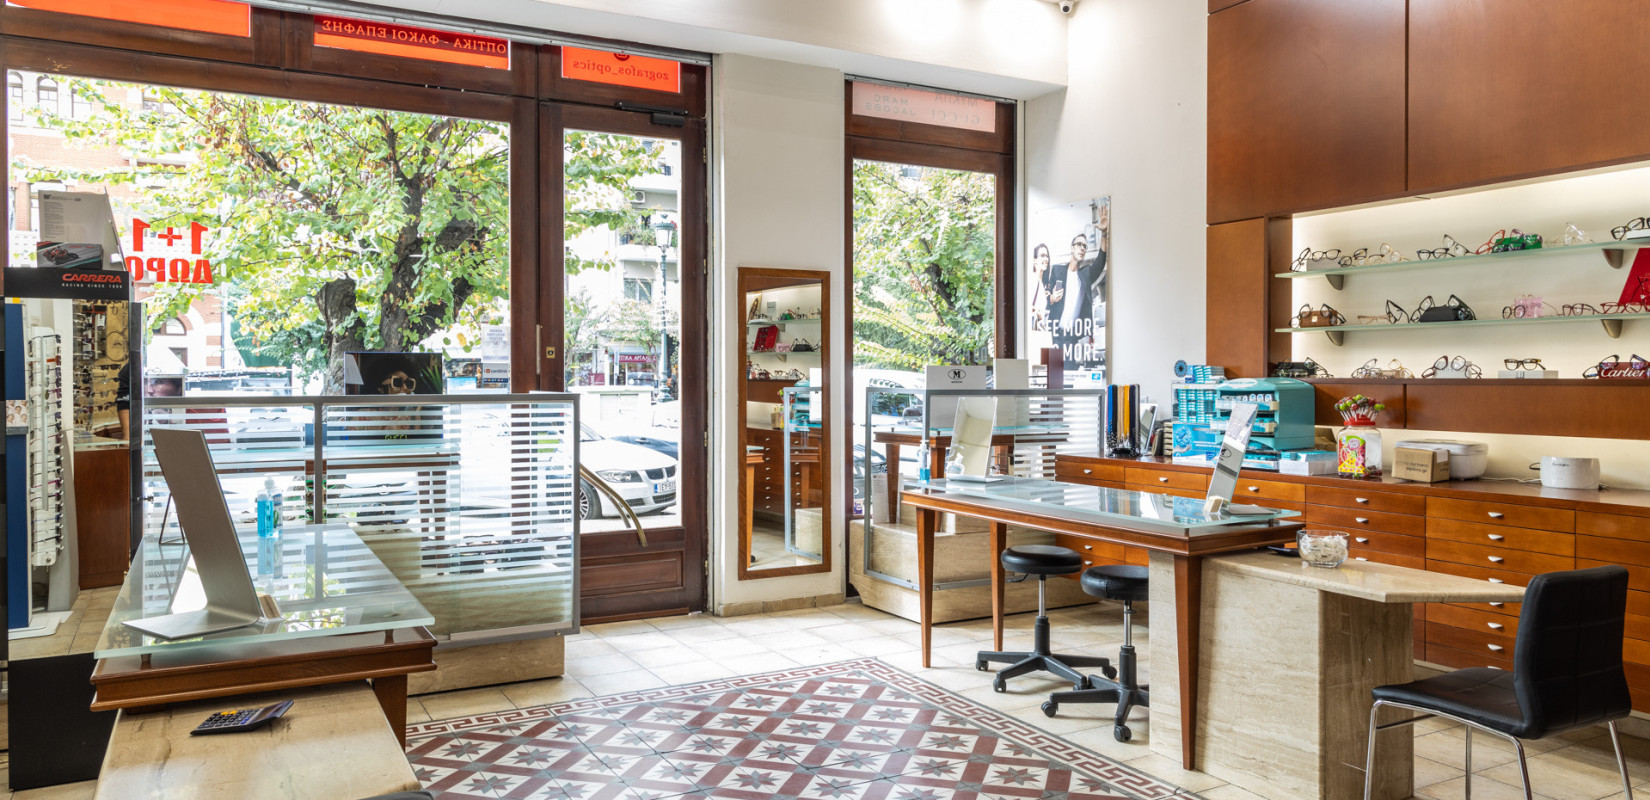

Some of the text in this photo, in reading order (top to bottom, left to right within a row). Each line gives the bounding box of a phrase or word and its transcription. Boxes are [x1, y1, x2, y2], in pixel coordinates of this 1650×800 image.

[62, 273, 122, 283] CARRERA
[1036, 318, 1100, 337] SEE MORE
[1063, 343, 1104, 362] MORE.
[1600, 367, 1646, 378] Cartier
